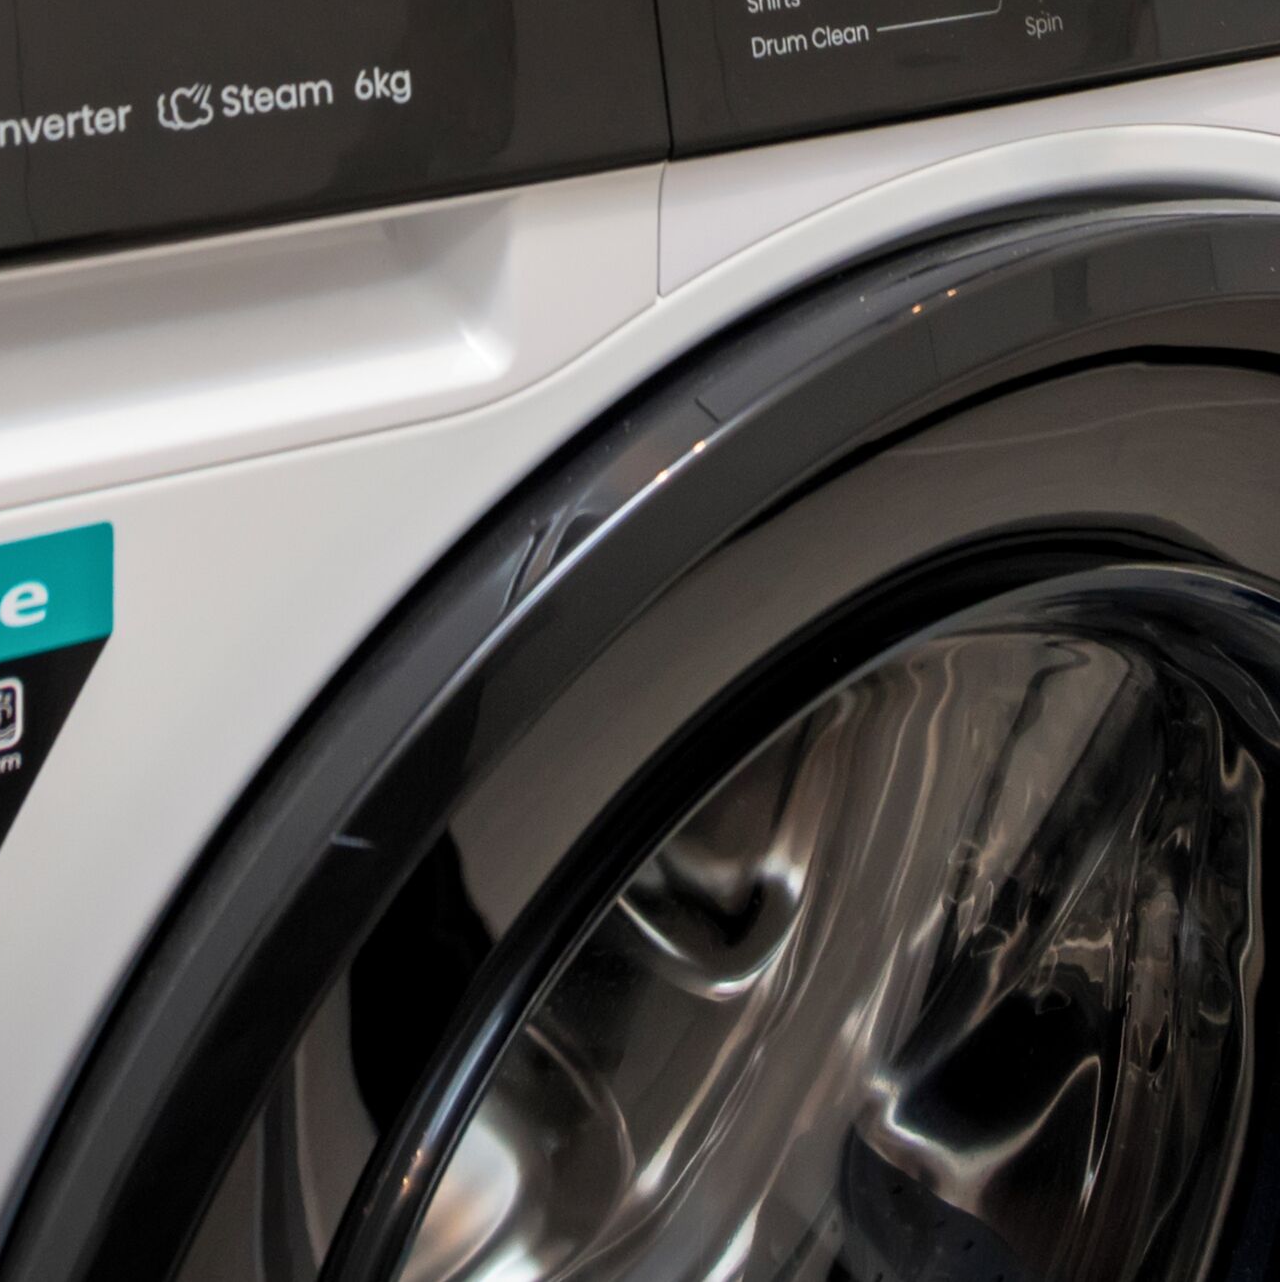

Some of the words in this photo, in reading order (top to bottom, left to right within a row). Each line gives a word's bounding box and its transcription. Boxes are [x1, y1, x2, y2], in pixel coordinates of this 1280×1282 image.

[751, 32, 808, 57] Drum
[812, 22, 869, 49] Clean
[1025, 13, 1063, 38] Spin
[221, 76, 333, 117] Steam
[354, 67, 412, 103] 6kg
